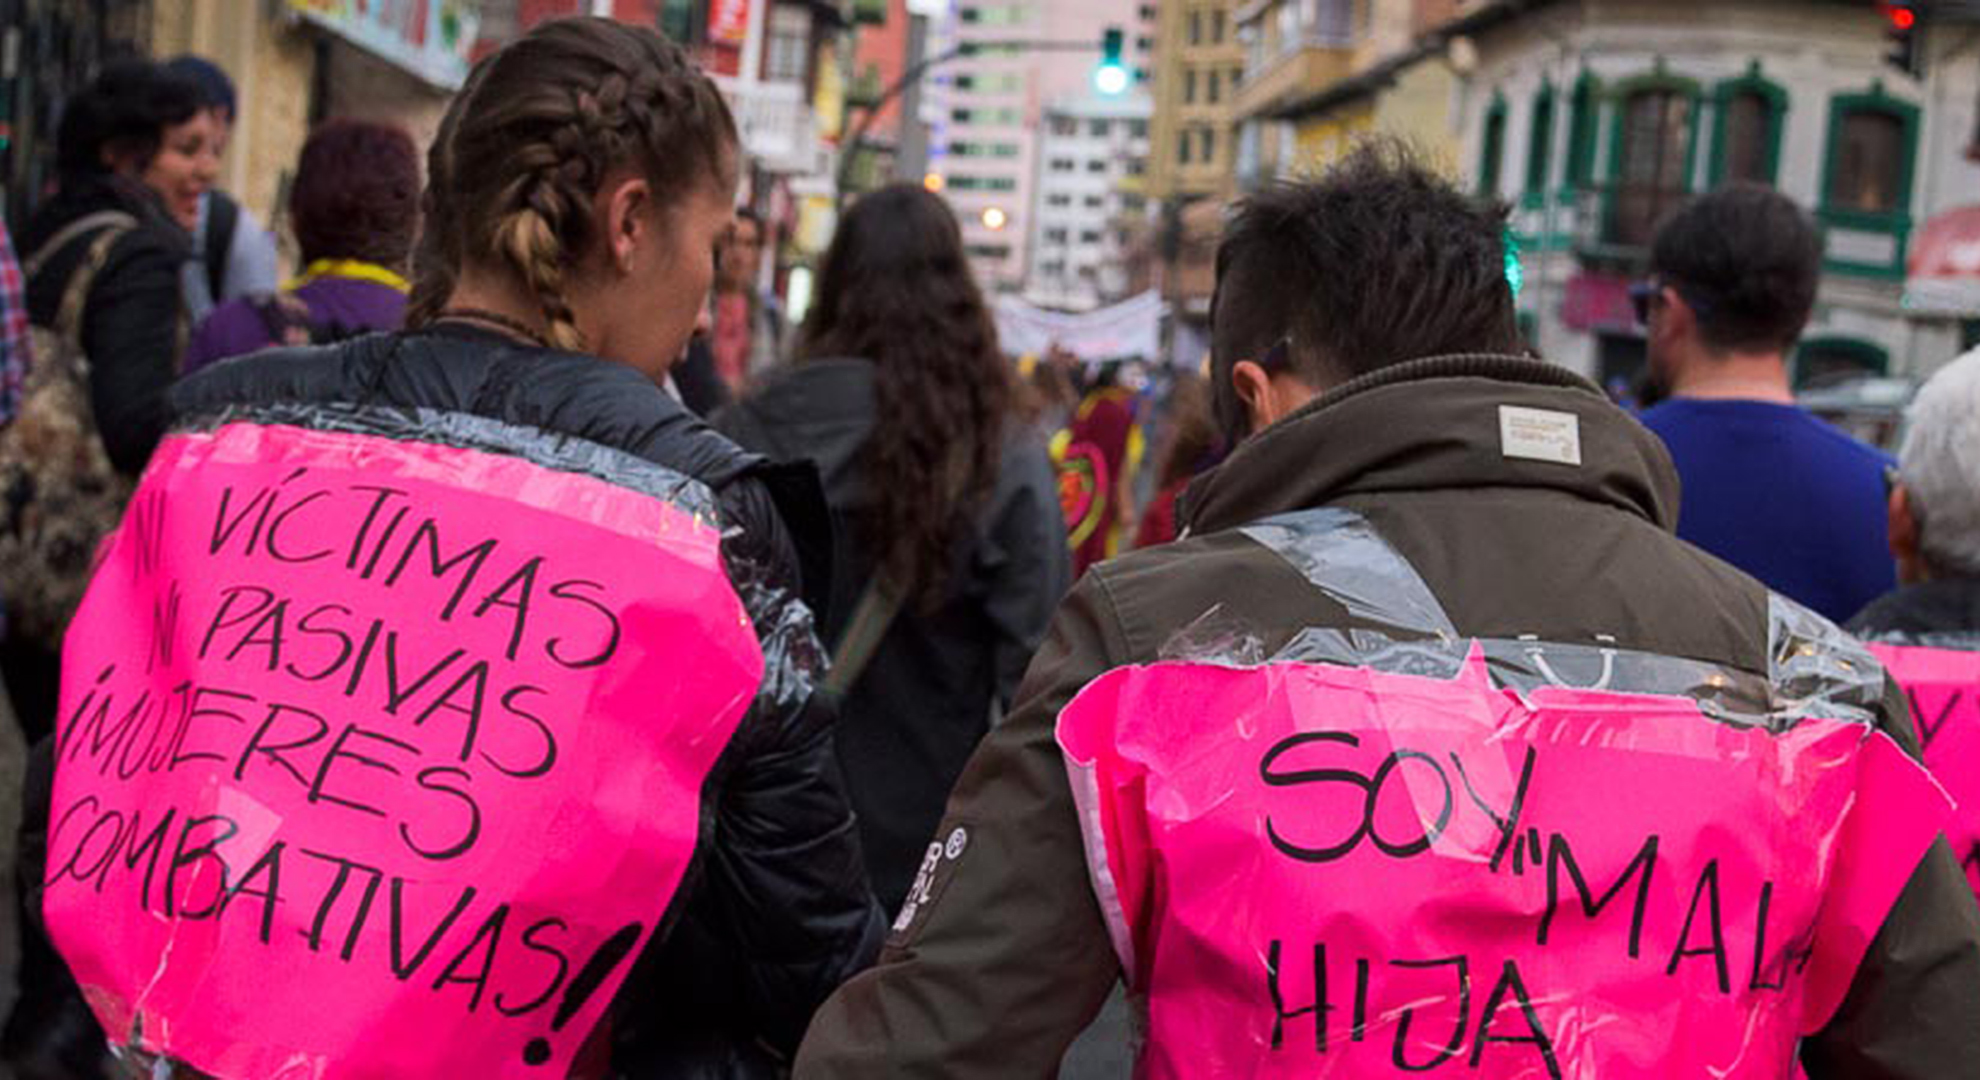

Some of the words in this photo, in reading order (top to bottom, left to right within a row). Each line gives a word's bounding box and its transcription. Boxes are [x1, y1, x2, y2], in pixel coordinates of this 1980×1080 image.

[208, 467, 622, 669] VÍCTIMAS
[198, 584, 557, 779] PASIVAS
[1260, 731, 1536, 872] SOY
[43, 795, 645, 1066] COMBATIVAS!
[1267, 939, 1562, 1080] HIJA
